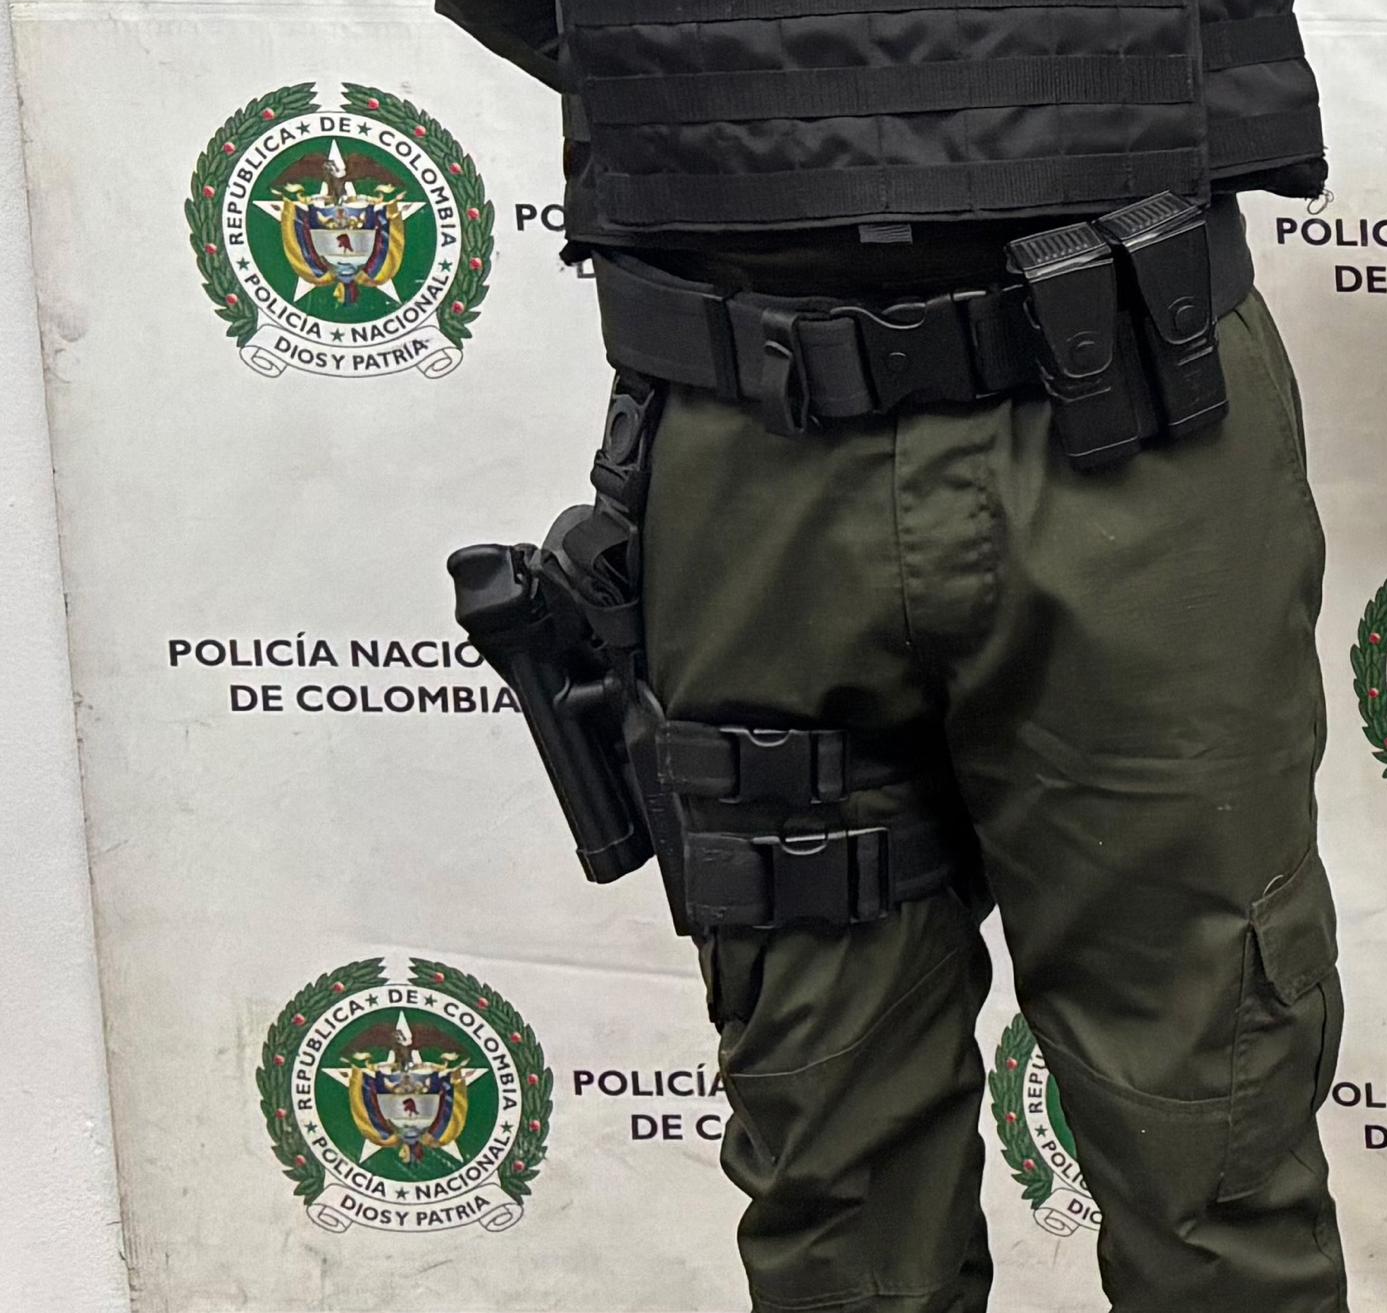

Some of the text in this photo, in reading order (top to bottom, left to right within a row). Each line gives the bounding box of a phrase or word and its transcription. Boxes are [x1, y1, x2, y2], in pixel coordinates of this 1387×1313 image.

[319, 116, 351, 133] DE
[378, 130, 456, 247] COLOMBIA
[1335, 265, 1387, 293] DE
[351, 276, 449, 342] NACIONAL
[352, 339, 429, 370] PATRIA
[169, 632, 485, 668] POLICÍA NACIO
[231, 685, 522, 713] DE COLOMBIA
[387, 989, 417, 1005] DE
[443, 1001, 517, 1111] COLOMBIA
[632, 1115, 682, 1140] DE
[415, 1137, 510, 1200] NACIONAL
[416, 1196, 490, 1226] PATRIA
